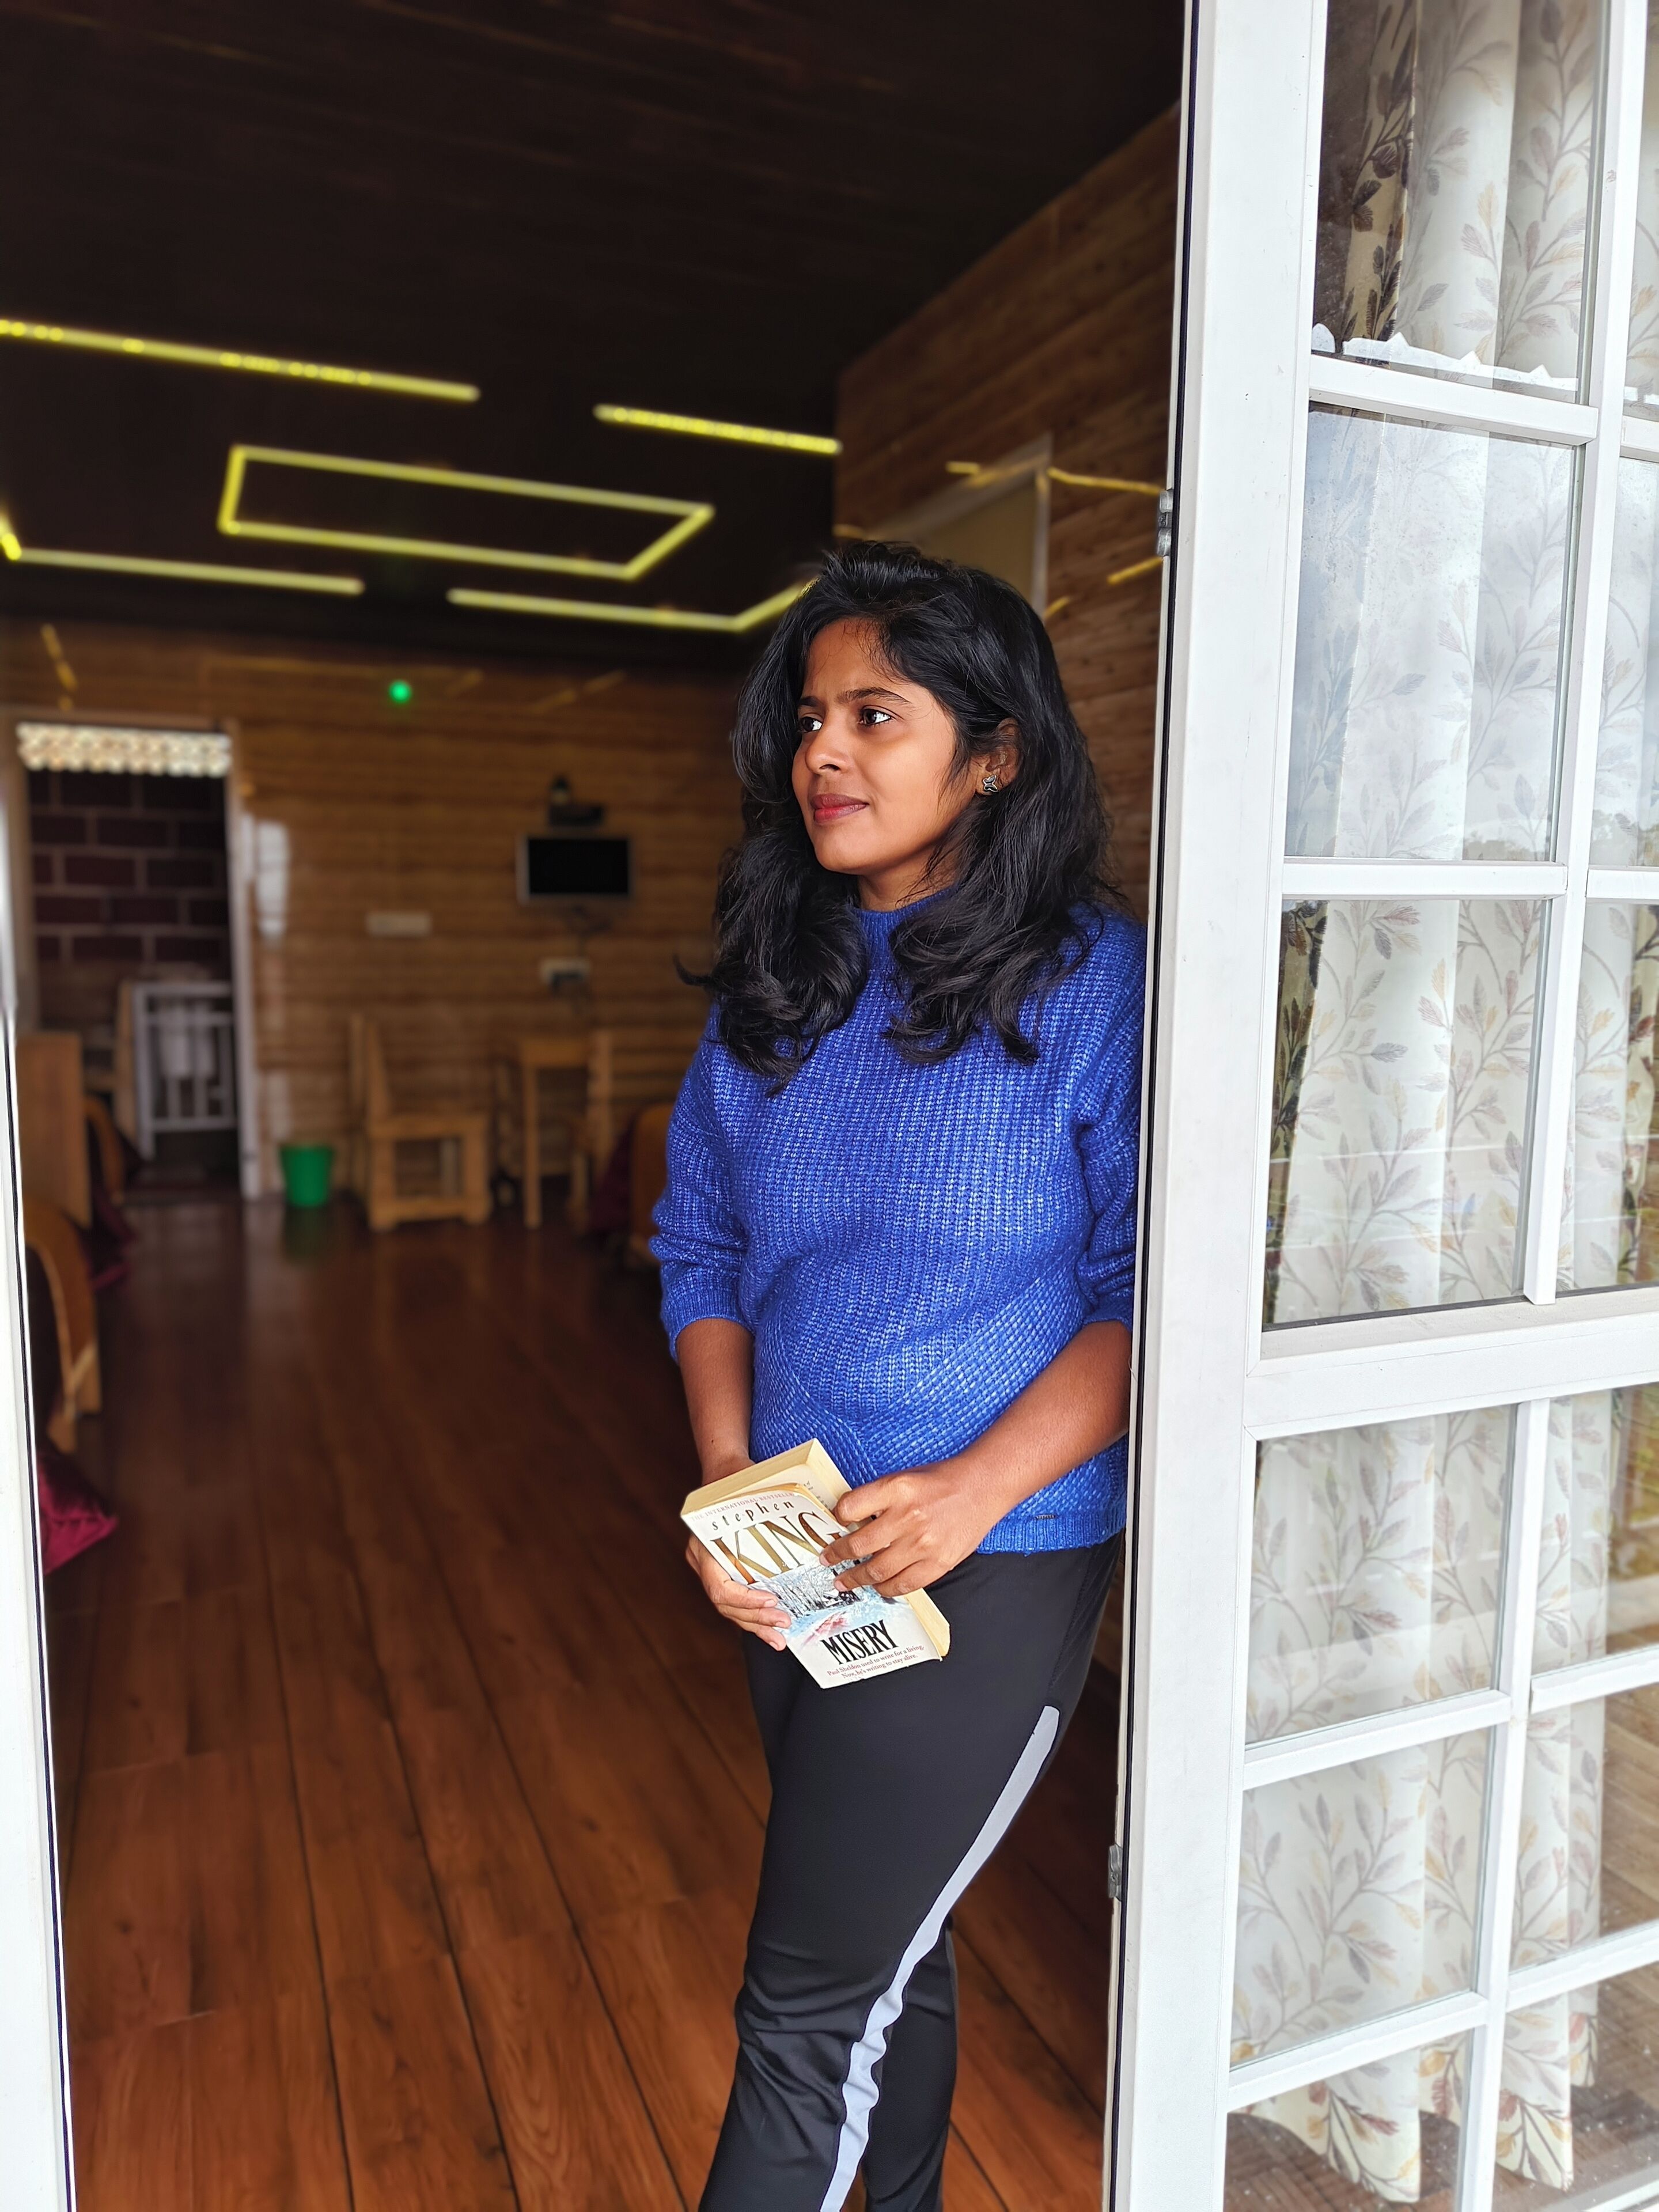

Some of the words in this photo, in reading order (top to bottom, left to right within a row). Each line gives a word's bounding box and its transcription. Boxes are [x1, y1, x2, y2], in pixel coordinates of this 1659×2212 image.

[704, 1497, 759, 1517] INTERNATIONAL
[712, 1501, 795, 1531] stephen
[710, 1510, 842, 1585] KING
[819, 1619, 899, 1665] MISERY
[839, 1664, 861, 1673] Sheldon
[861, 1659, 874, 1667] used
[866, 1664, 887, 1672] writing
